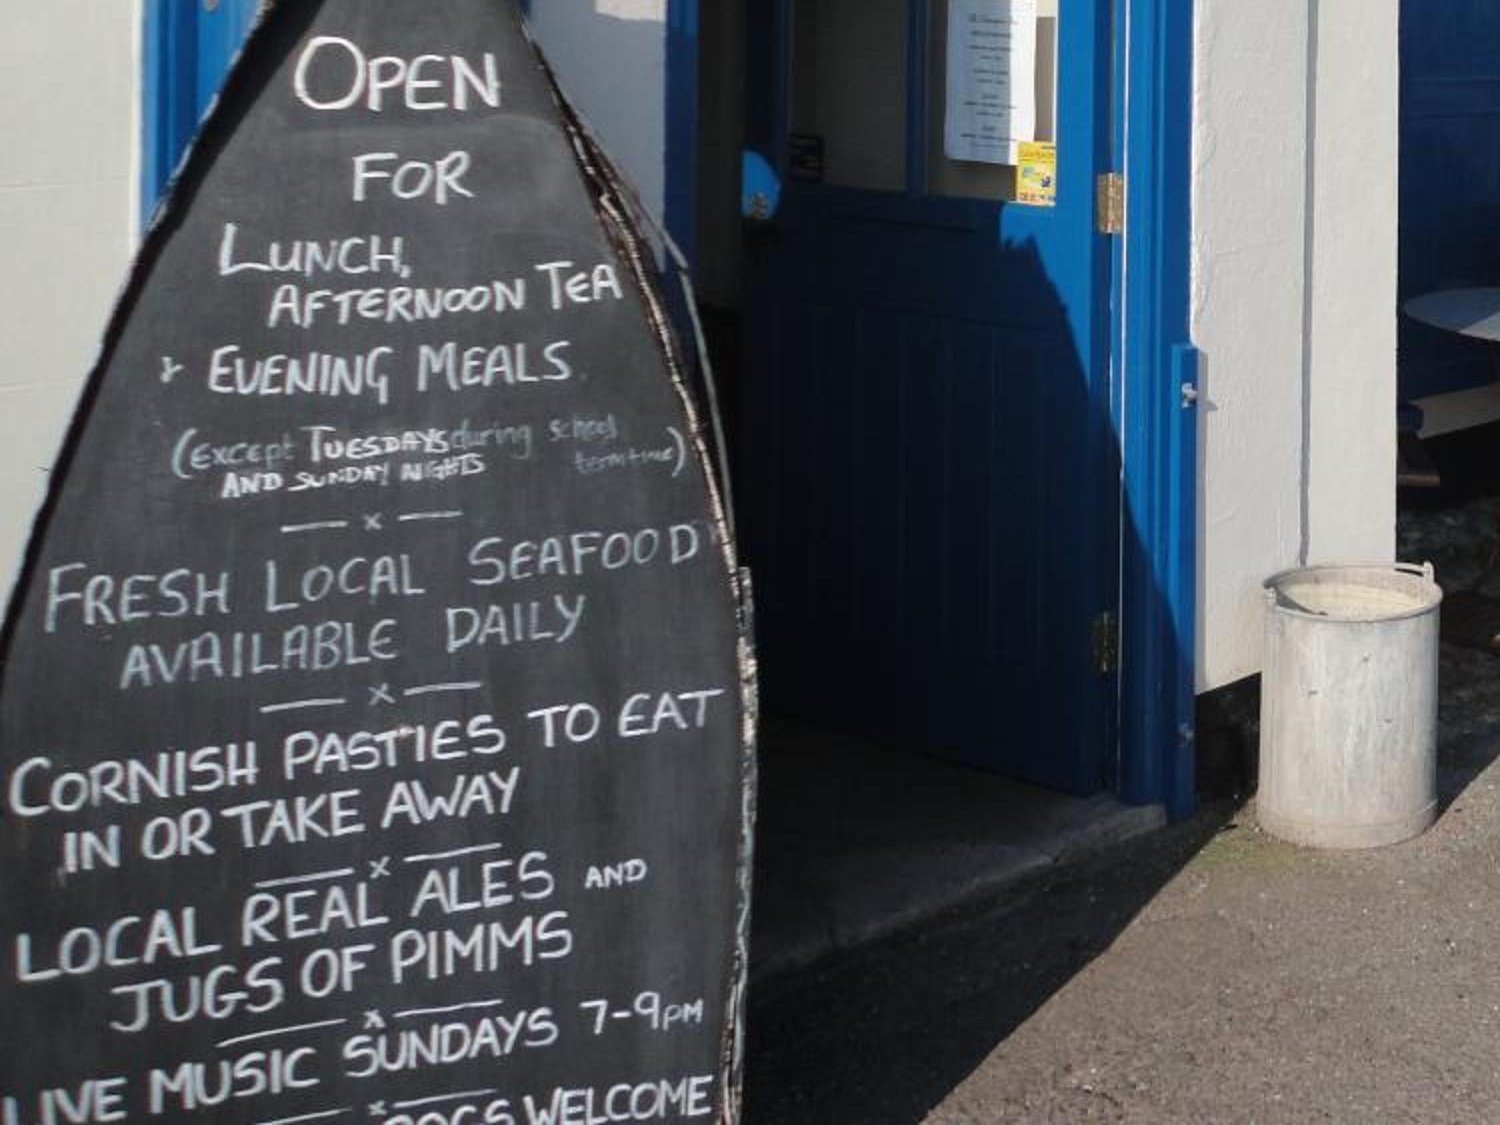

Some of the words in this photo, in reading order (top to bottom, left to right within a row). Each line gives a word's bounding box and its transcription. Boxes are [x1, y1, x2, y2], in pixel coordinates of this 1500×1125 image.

[294, 36, 502, 111] OPEN
[352, 150, 475, 204] FOR
[267, 278, 524, 328] AFTERNOON
[536, 259, 624, 303] TEA
[208, 344, 394, 403] EVENING
[416, 341, 572, 391] MEALS
[44, 563, 228, 632] FRESH
[265, 554, 425, 613] LOCAL
[468, 523, 698, 587] SEAFOOD
[119, 618, 397, 689] AVAILABLE
[446, 594, 586, 652] DAILY
[8, 742, 257, 817] CORNISH
[283, 715, 505, 780] PASTIES
[528, 703, 600, 748] TO
[617, 688, 725, 737] EAT
[63, 825, 120, 874] IN
[142, 810, 217, 860] OR
[221, 789, 364, 848] TAKE
[380, 767, 520, 830] AWAY
[15, 906, 222, 982] LOCAL
[241, 880, 390, 949] REAL
[411, 850, 556, 919] ALES
[110, 957, 285, 1033] JUGS
[300, 947, 367, 998] OF
[391, 911, 573, 984] PIMMS
[149, 1047, 321, 1115] MUSIC
[343, 1007, 559, 1077] SUNDAYS
[522, 1074, 714, 1125] WELCOME
